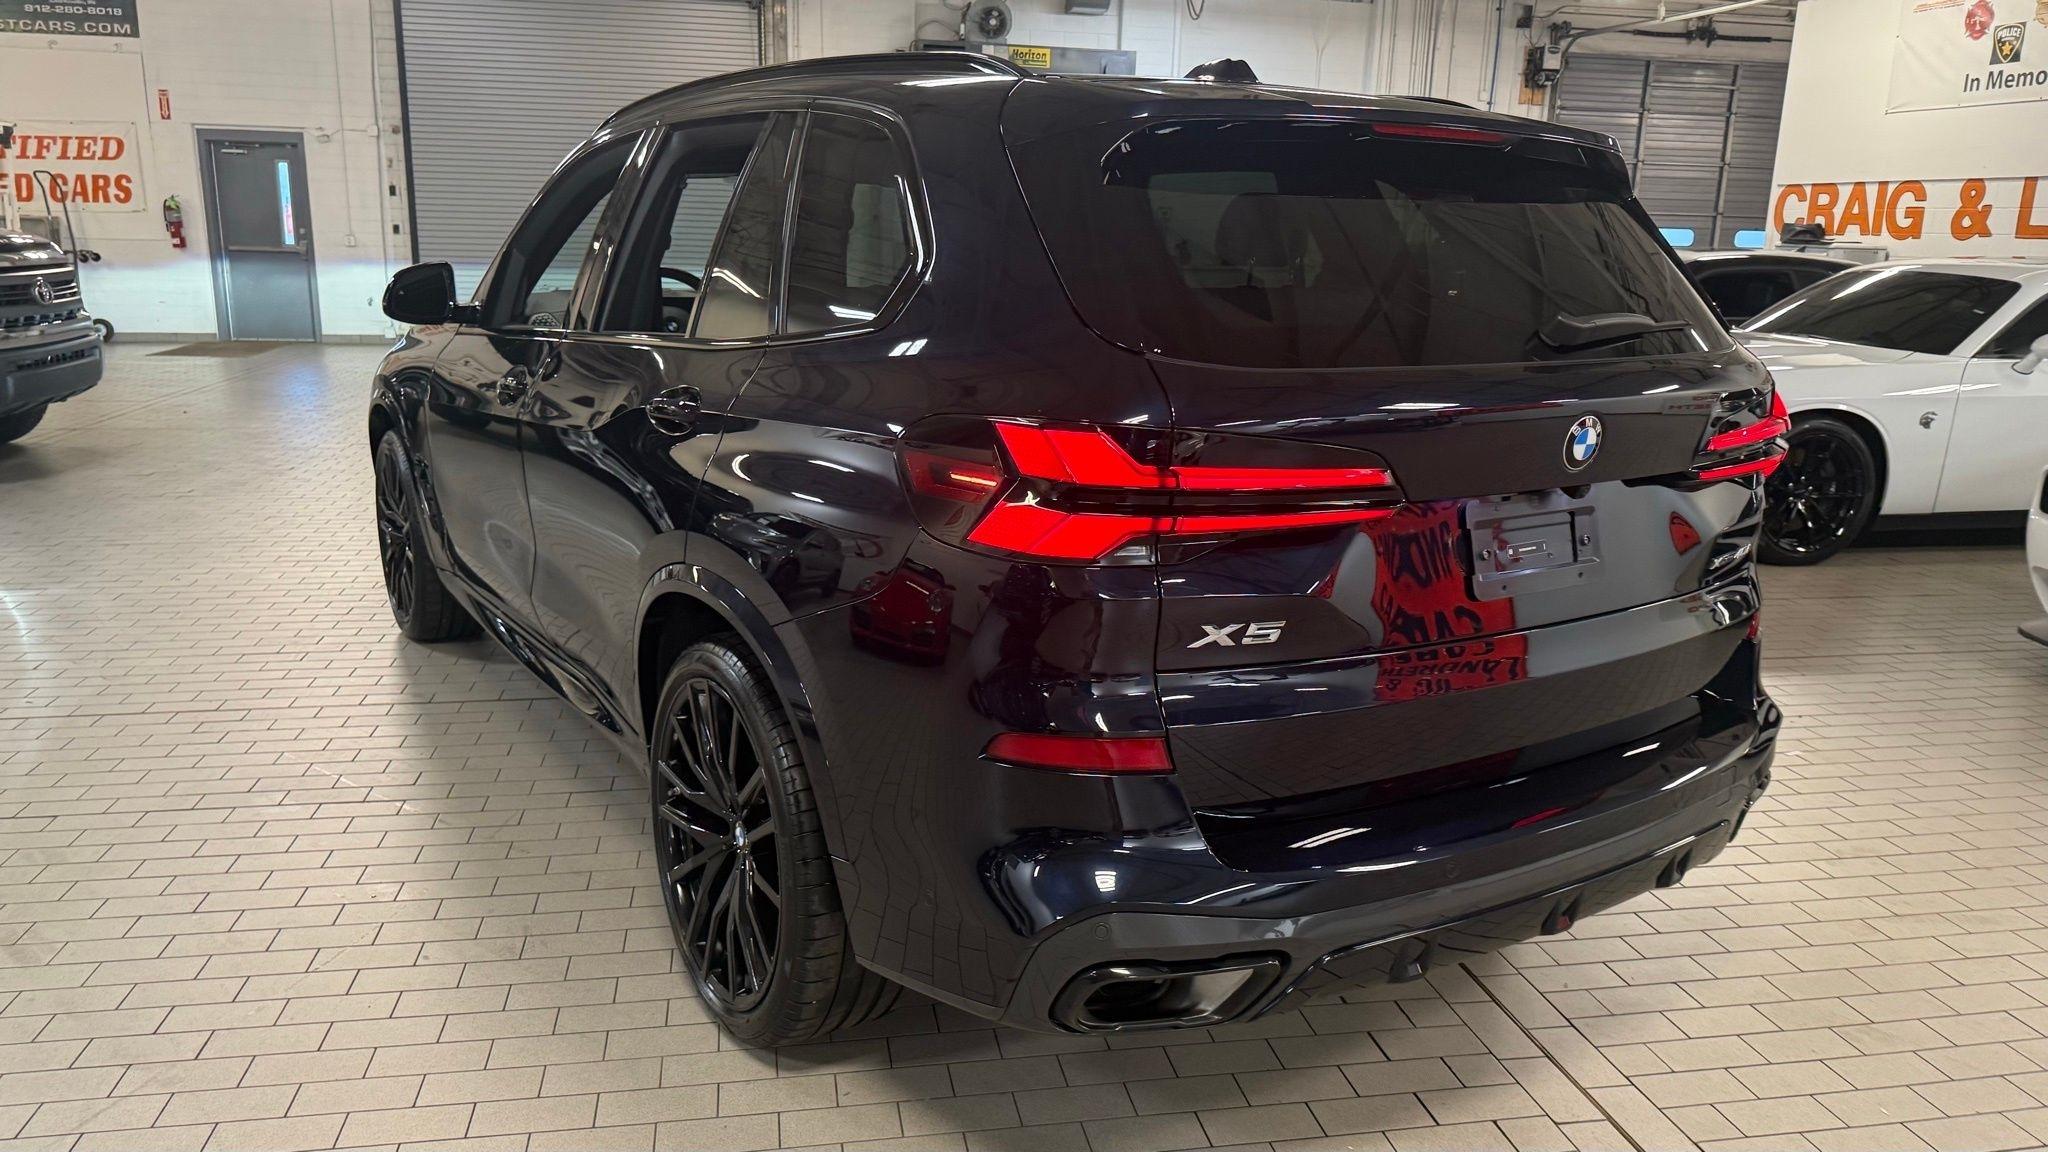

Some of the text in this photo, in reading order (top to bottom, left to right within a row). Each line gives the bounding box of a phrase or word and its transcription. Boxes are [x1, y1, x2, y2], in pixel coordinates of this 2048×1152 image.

[24, 4, 122, 16] 812-280-8018
[1998, 27, 2021, 39] POLICE
[1012, 49, 1047, 60] Horizon
[1963, 69, 2048, 93] In Memo
[0, 135, 125, 160] IFIED
[49, 173, 132, 204] CARS
[1774, 180, 1927, 241] CRAIG
[1950, 178, 1992, 241] &
[1187, 620, 1286, 648] X5
